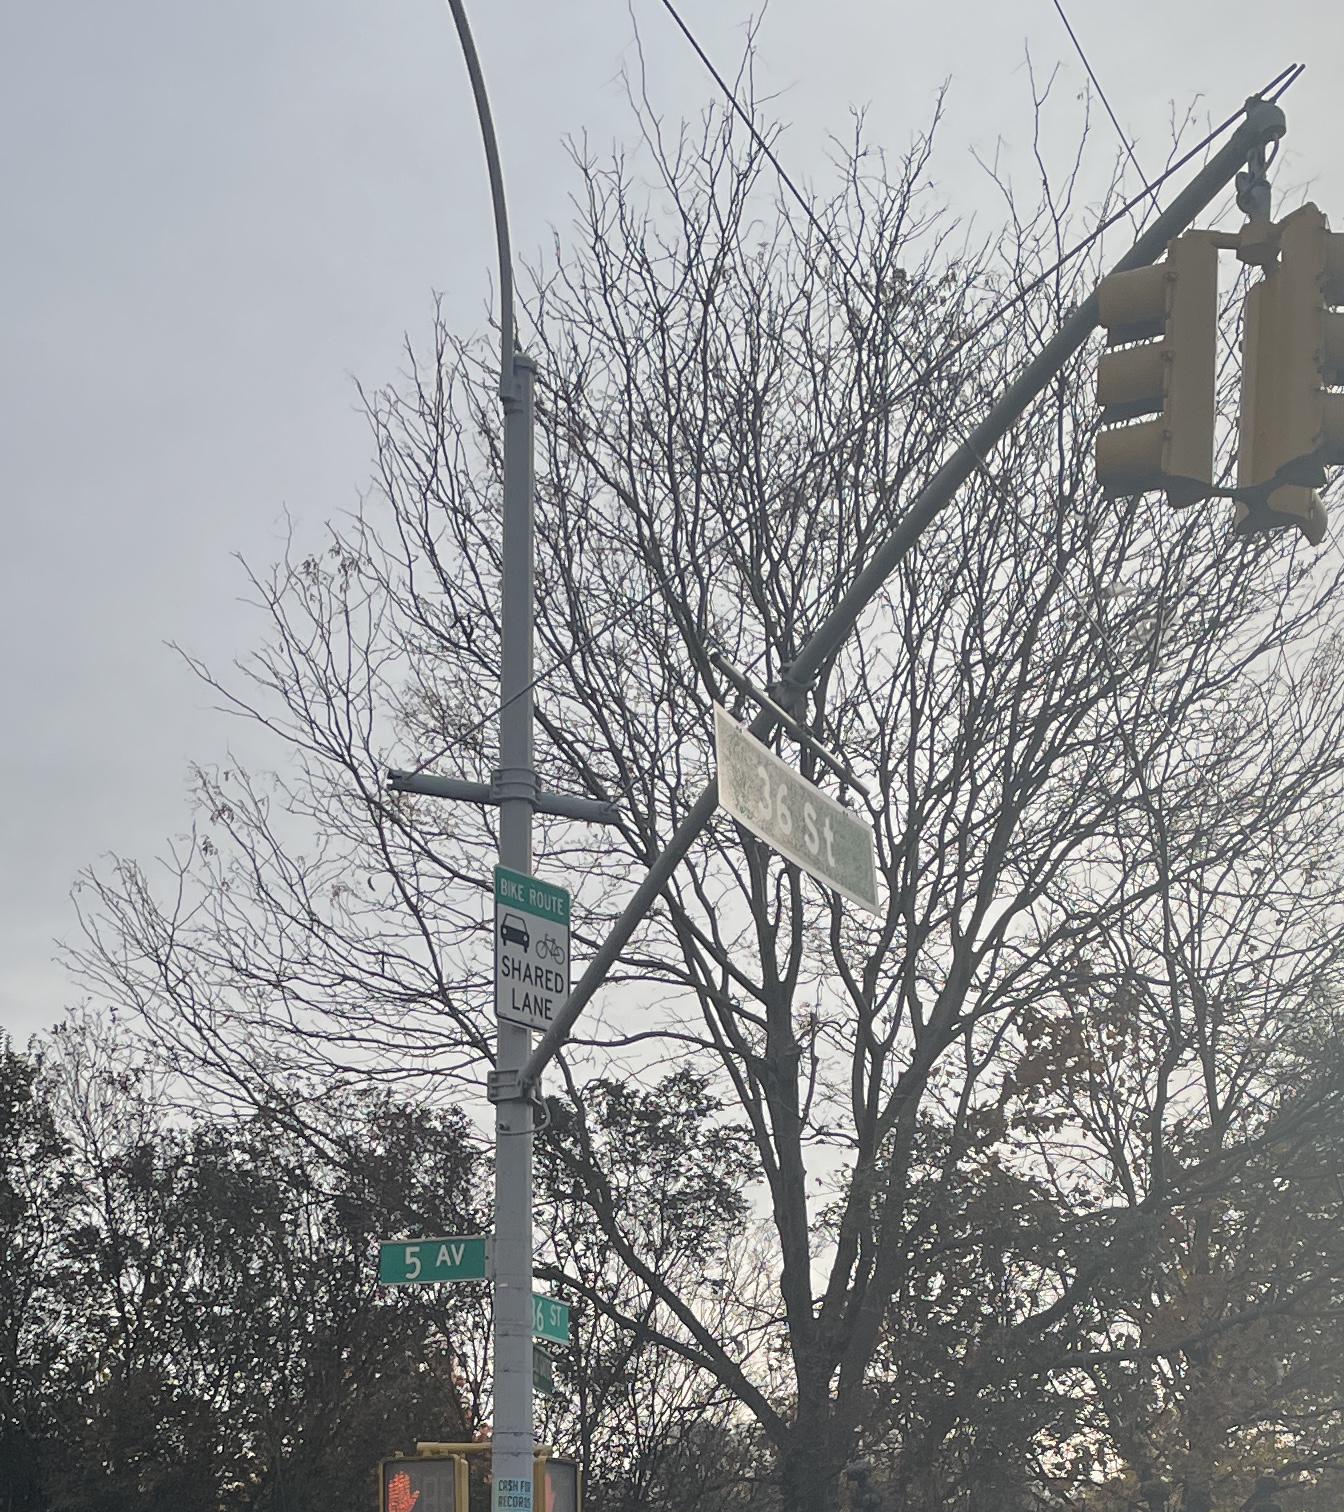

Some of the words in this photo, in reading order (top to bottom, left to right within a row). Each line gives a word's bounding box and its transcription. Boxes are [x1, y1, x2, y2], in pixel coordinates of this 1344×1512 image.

[757, 765, 792, 835] 36
[804, 802, 836, 867] St
[500, 878, 525, 902] BIKE
[529, 888, 565, 916] ROUTE
[501, 955, 564, 994] SHARED
[512, 988, 553, 1021] LANE
[405, 1246, 422, 1280] 5
[436, 1244, 465, 1267] AV
[549, 1305, 562, 1327] ST
[498, 1479, 519, 1492] CASH
